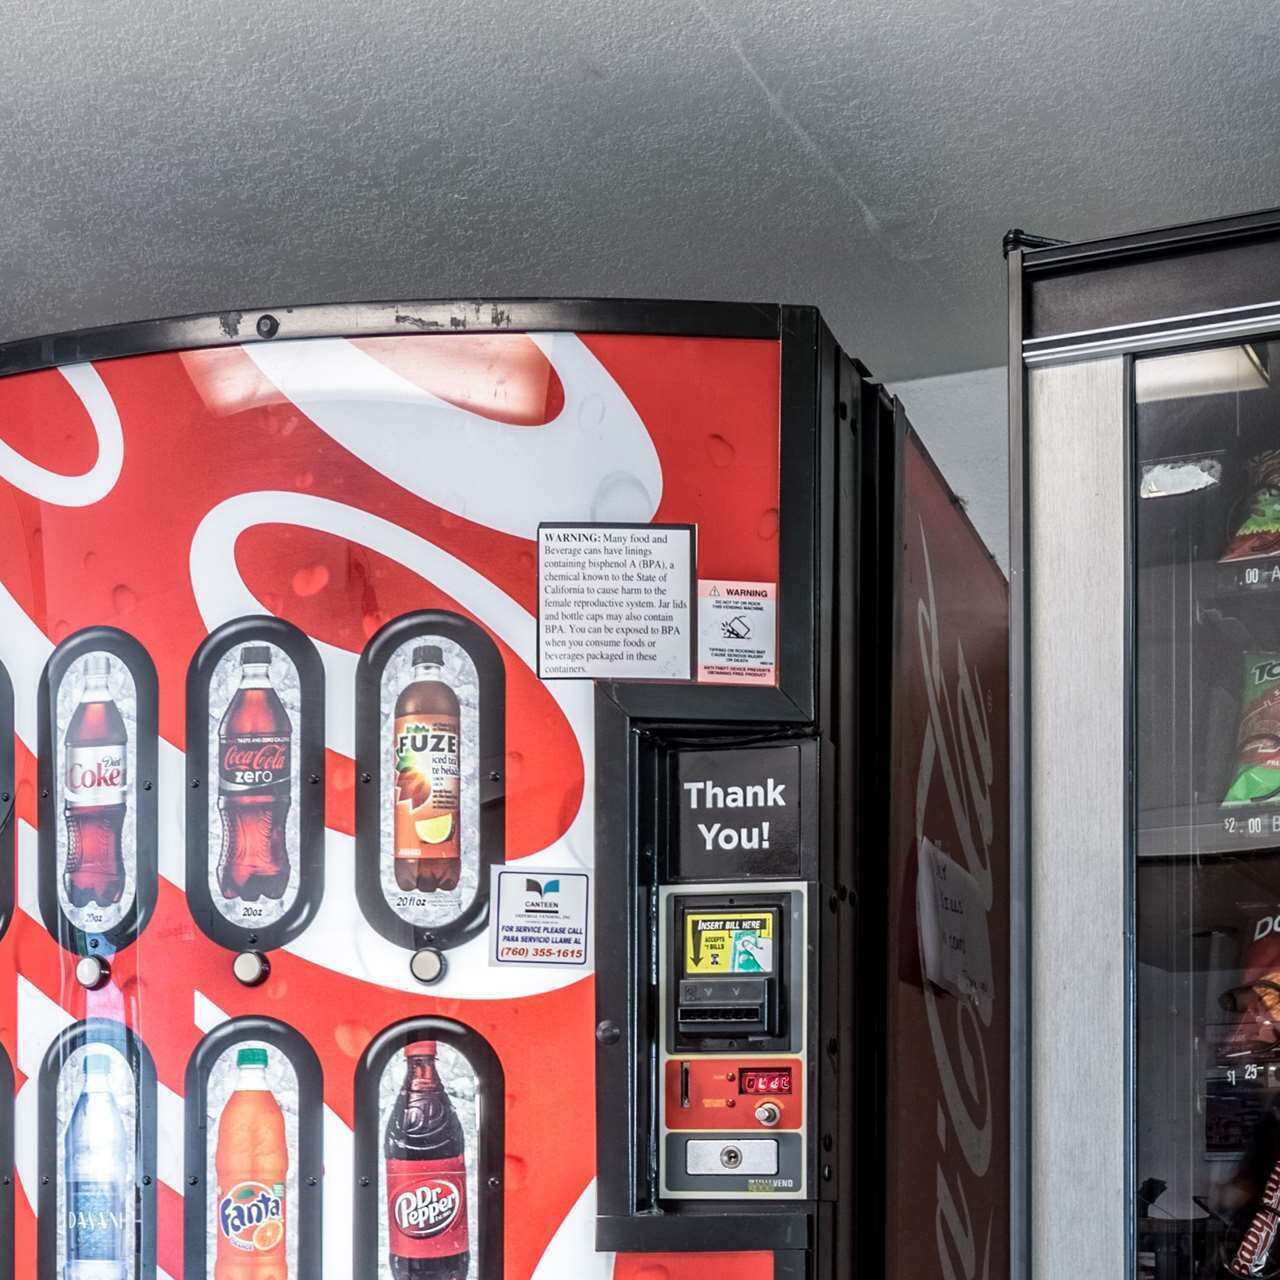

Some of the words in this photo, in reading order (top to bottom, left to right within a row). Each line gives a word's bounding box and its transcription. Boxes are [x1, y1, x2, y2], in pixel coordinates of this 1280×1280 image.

[545, 533, 600, 542] WARNING:
[604, 534, 626, 545] Many
[630, 534, 649, 543] food
[652, 535, 668, 544] and
[545, 546, 582, 556] Beverage
[604, 546, 624, 555] have
[625, 546, 652, 556] linings
[544, 560, 586, 570] containing
[589, 560, 626, 570] bisphenol
[544, 573, 580, 581] chemical
[582, 573, 609, 581] known
[622, 573, 634, 581] the
[636, 573, 656, 581] State
[659, 573, 668, 581] of
[726, 589, 767, 597] WARNING
[400, 734, 456, 753] FUZE
[224, 744, 286, 770] Coca-Cola
[70, 762, 121, 789] Coke
[235, 770, 272, 783] zero
[684, 778, 785, 809] Thank
[697, 822, 769, 850] You!
[698, 920, 723, 930] INSERT
[726, 921, 739, 929] BILL
[501, 947, 528, 957] (760)
[532, 949, 582, 957] 355-1615
[417, 1186, 441, 1206] Dr
[221, 1193, 280, 1236] Fanta
[395, 1191, 455, 1230] Pepper
